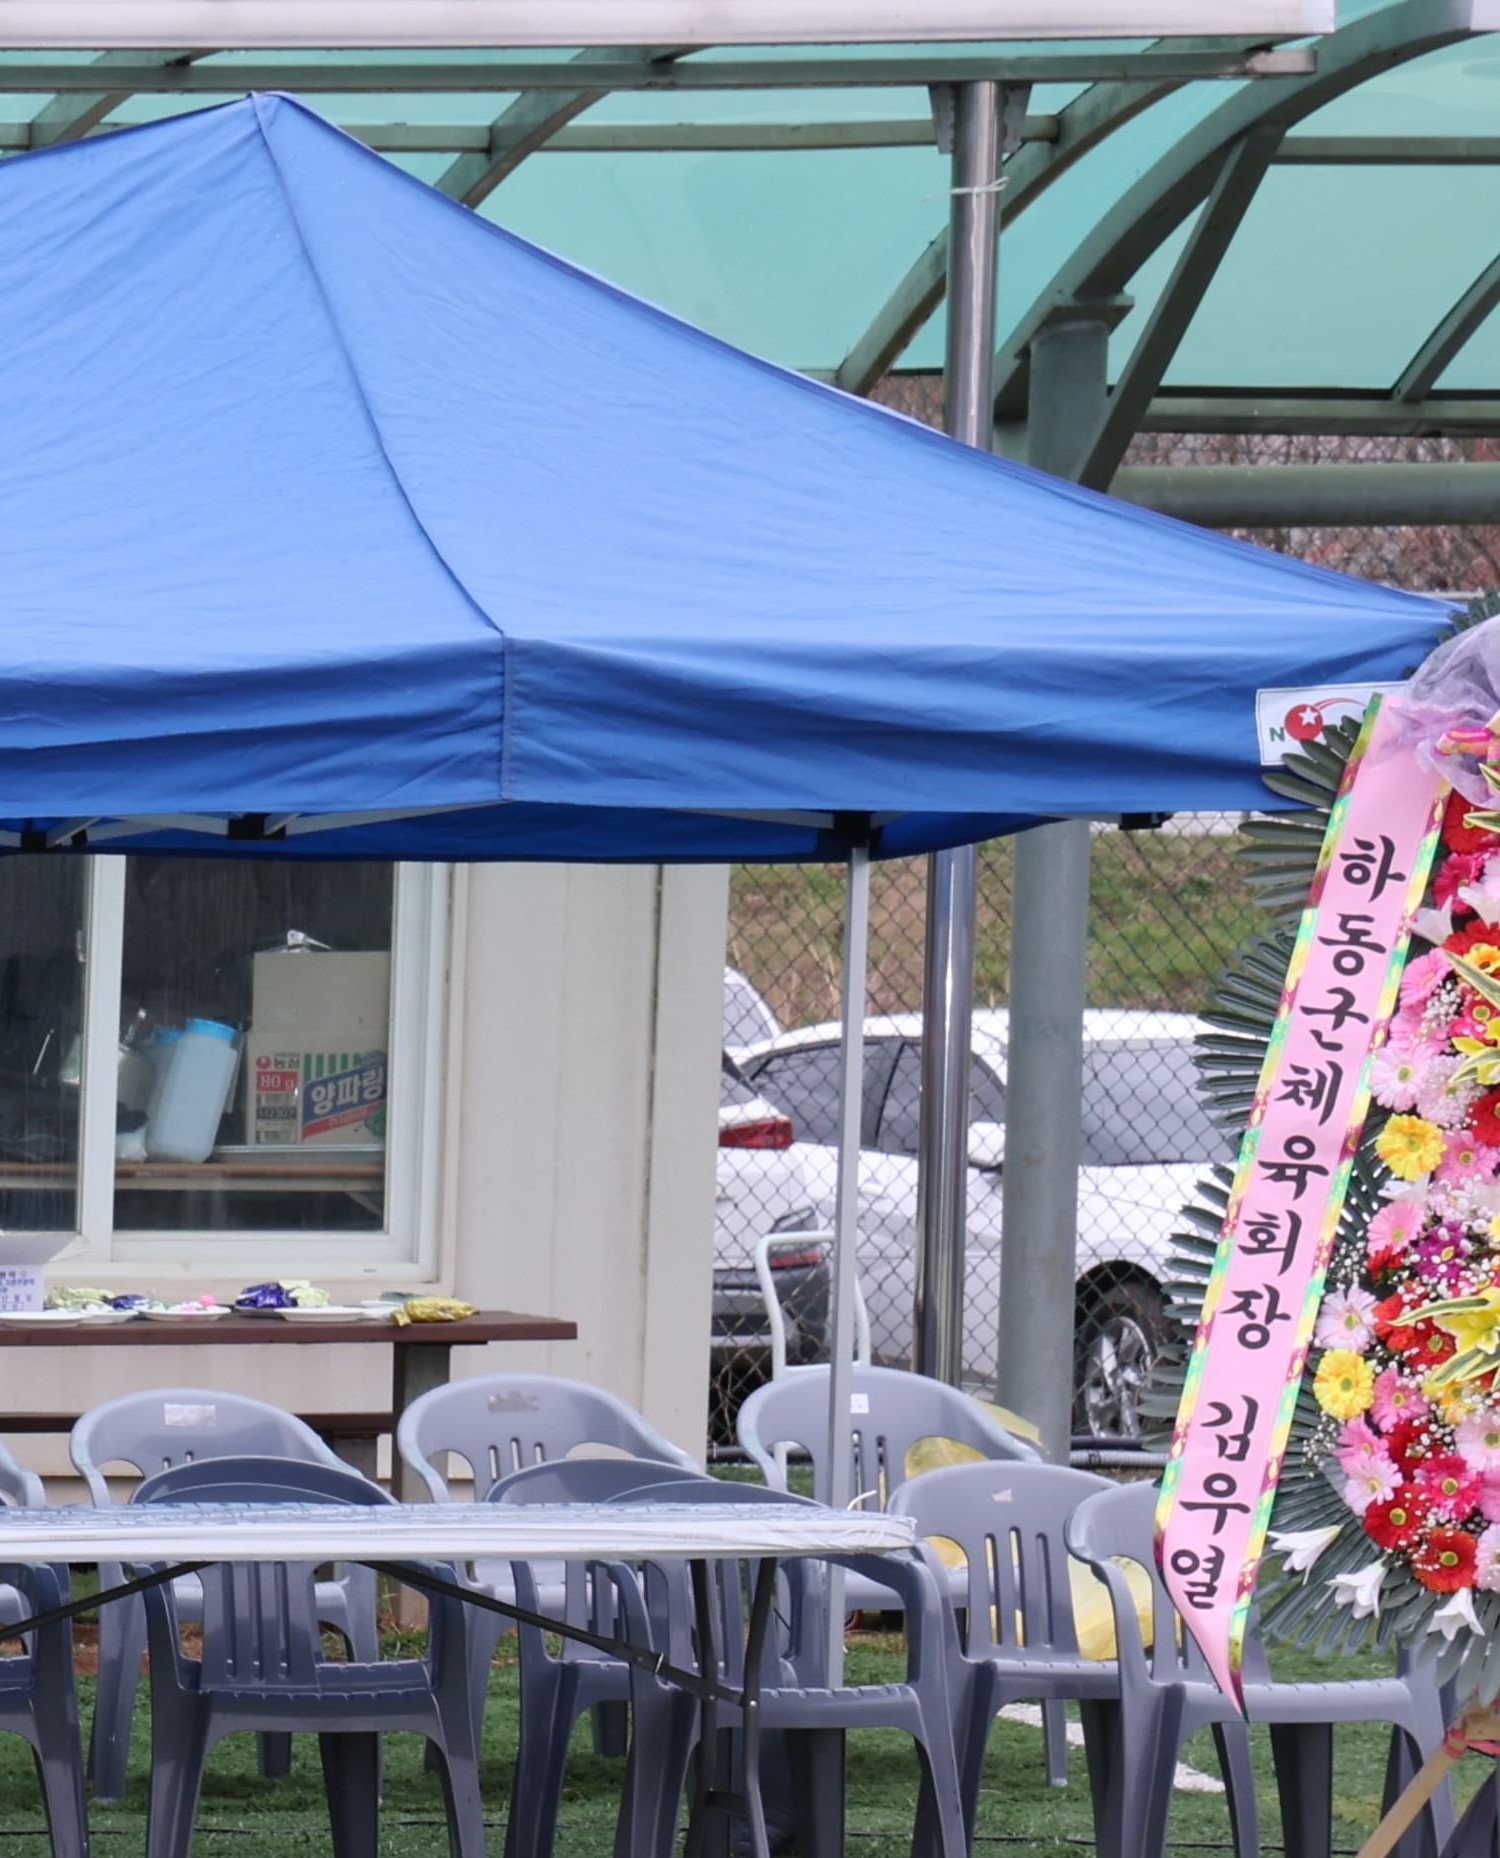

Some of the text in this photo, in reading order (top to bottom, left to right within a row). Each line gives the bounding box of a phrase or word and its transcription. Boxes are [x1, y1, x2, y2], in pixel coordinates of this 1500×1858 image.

[310, 1066, 384, 1116] 양파링
[1169, 834, 1407, 1611] 하동군체육회장 김우열
